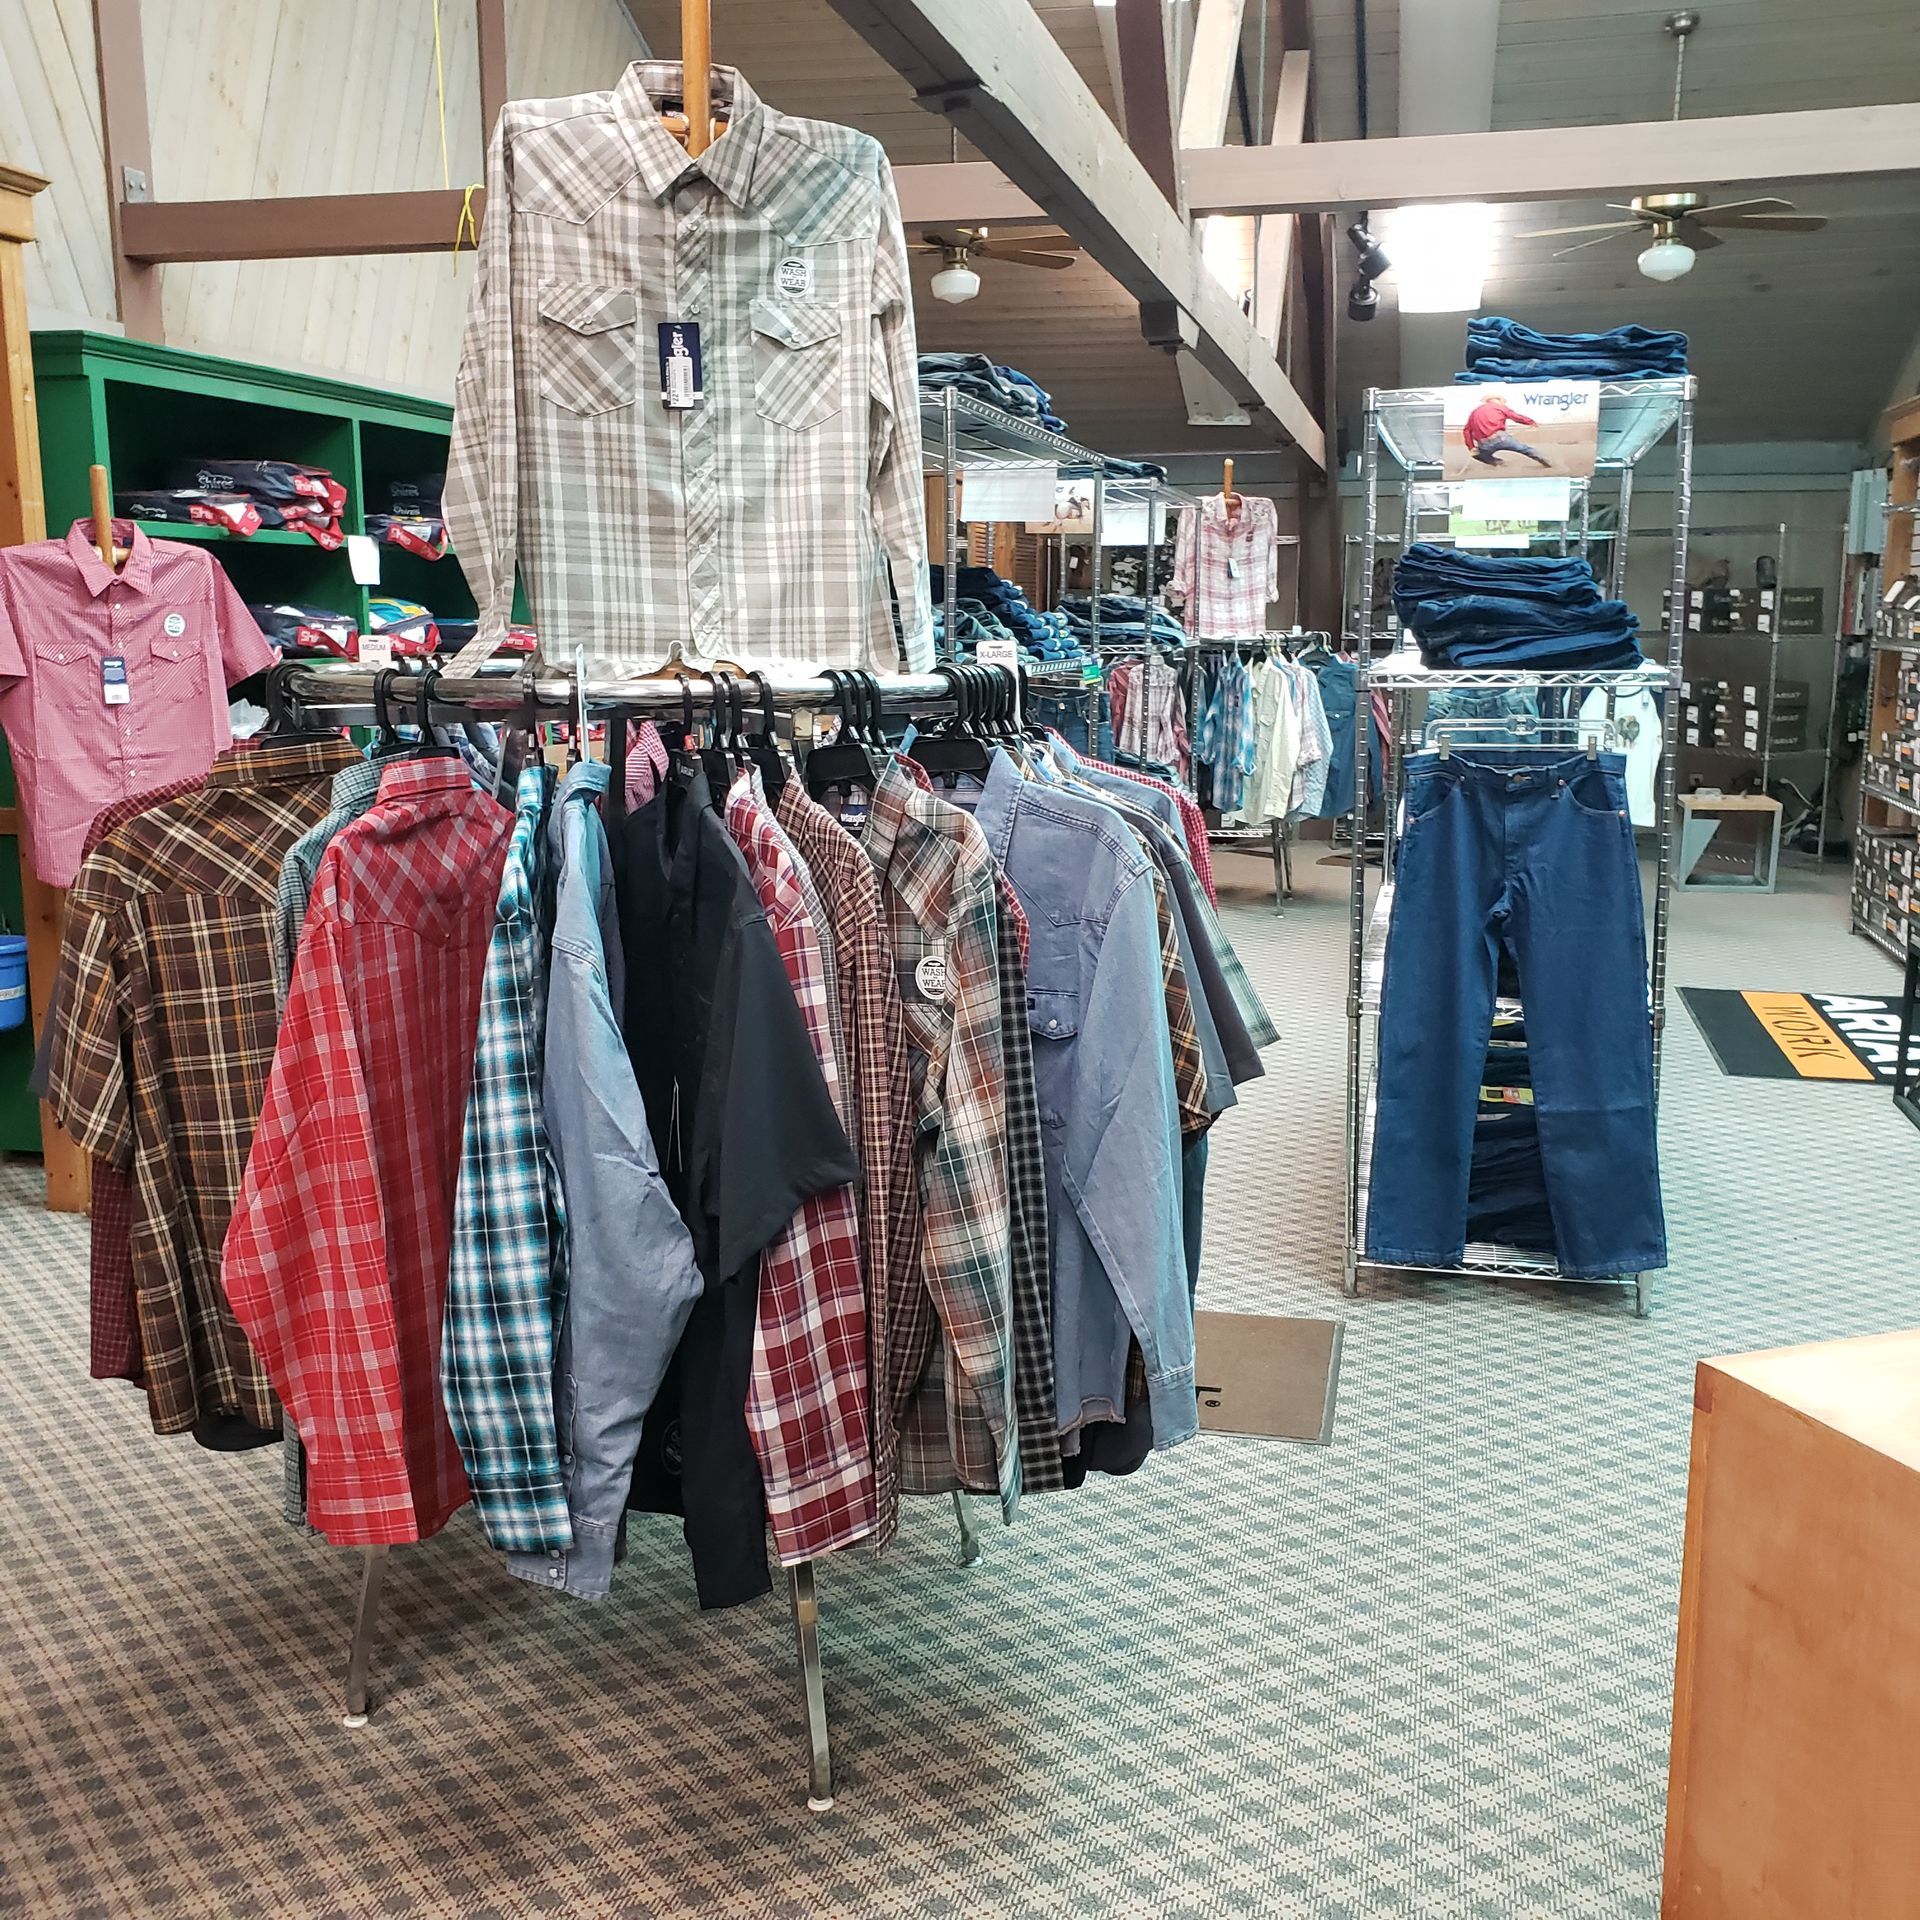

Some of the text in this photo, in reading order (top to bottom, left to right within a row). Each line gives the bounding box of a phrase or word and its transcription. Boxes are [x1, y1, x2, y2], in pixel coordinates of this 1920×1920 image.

[671, 331, 690, 357] gler
[1523, 392, 1589, 411] Wrangler
[979, 650, 1014, 659] X-LARGE
[1762, 1006, 1847, 1060] WORK
